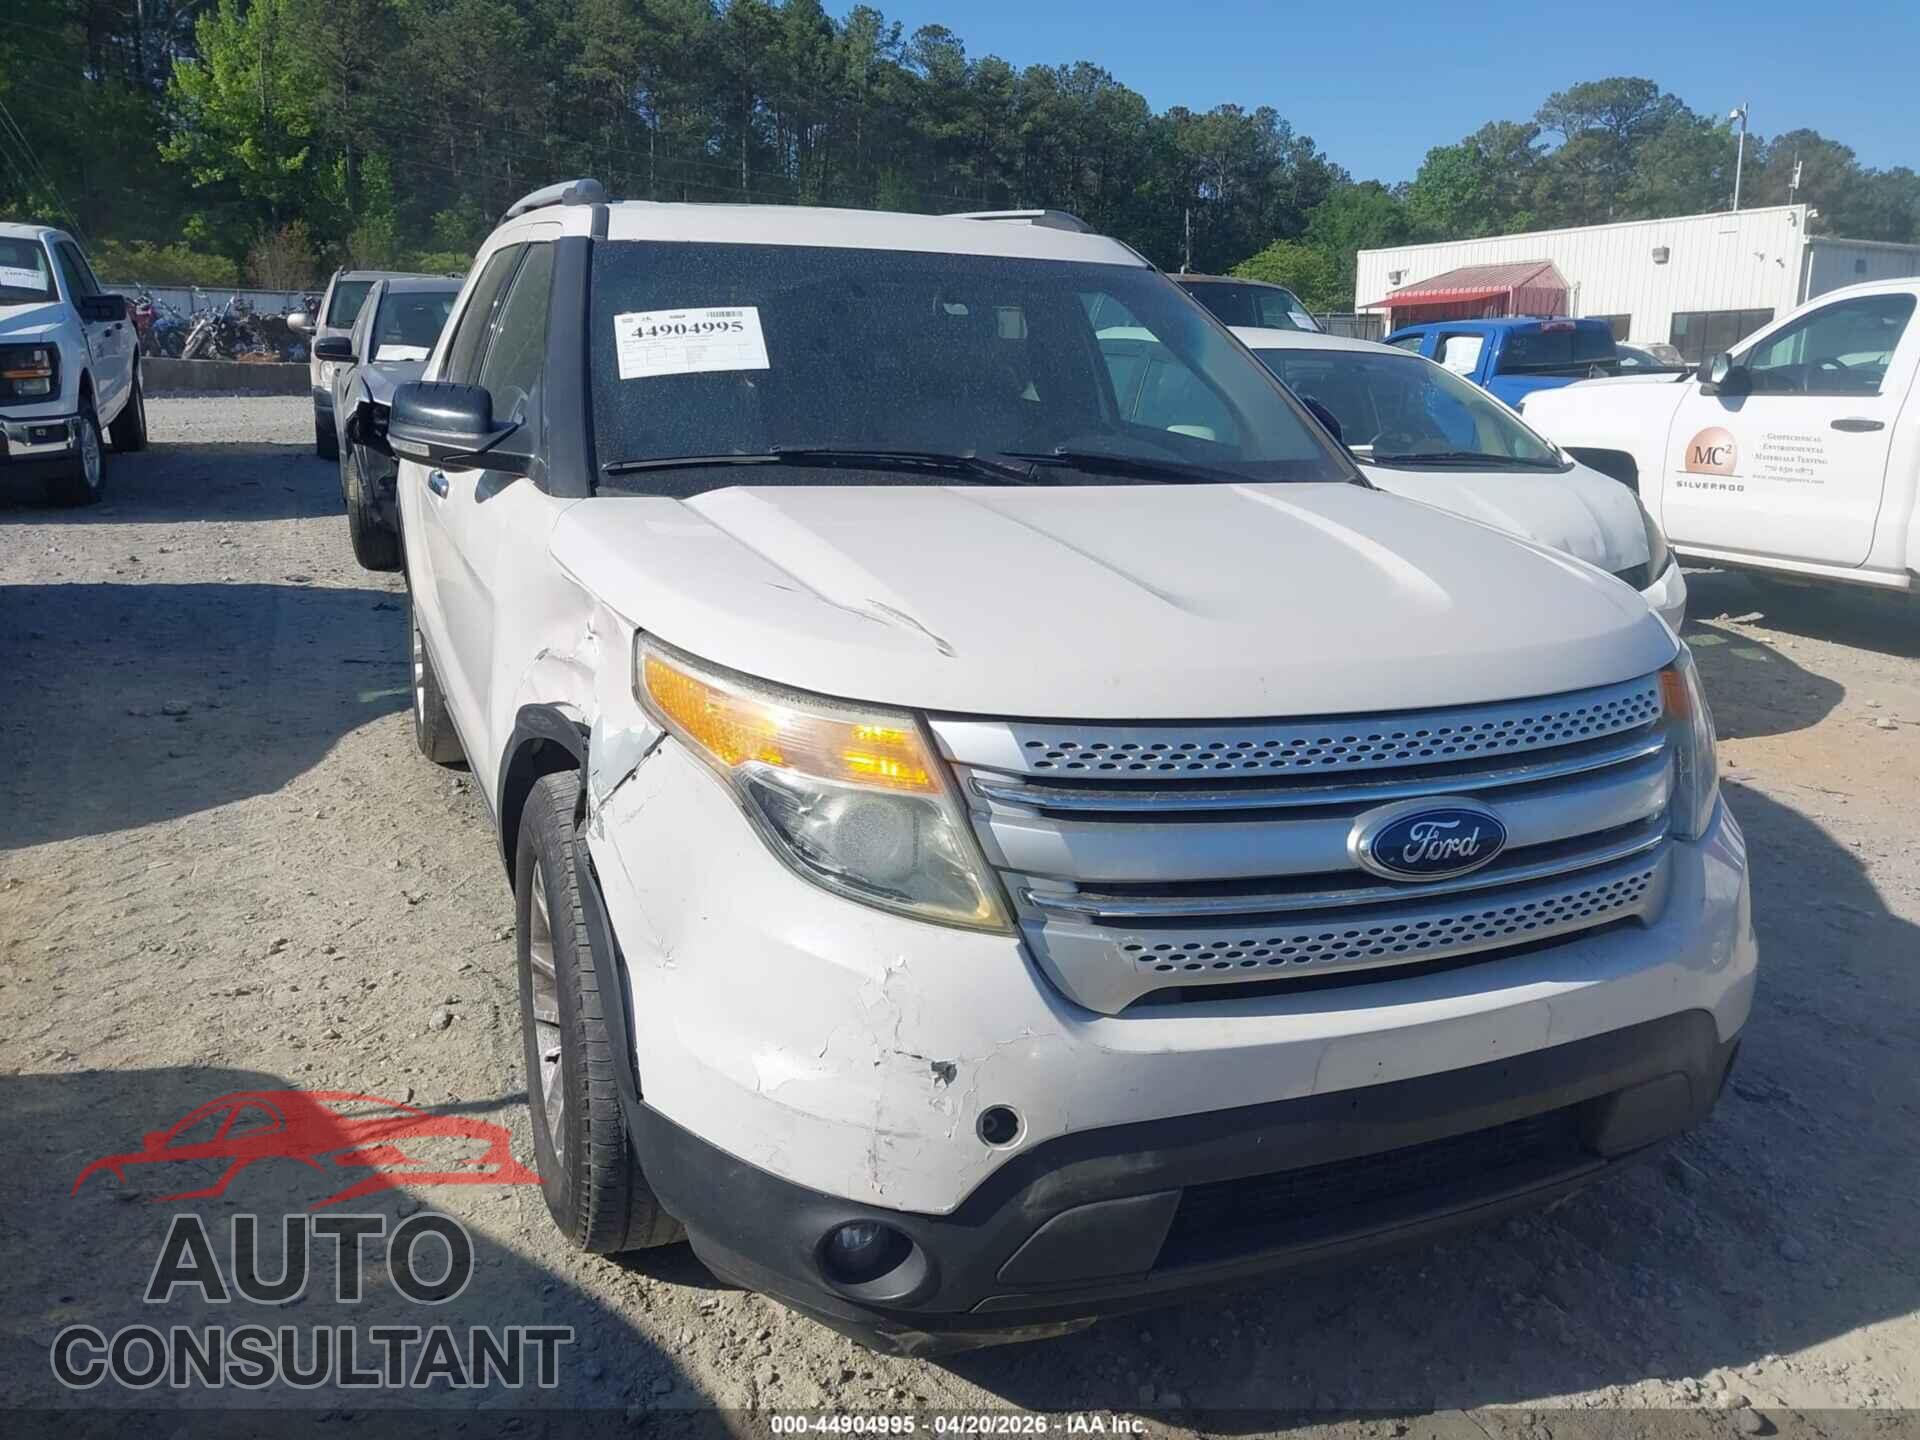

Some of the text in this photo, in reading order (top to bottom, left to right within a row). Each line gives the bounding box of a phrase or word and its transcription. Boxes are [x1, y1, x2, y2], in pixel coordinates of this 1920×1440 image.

[631, 320, 744, 338] 44904995
[1676, 480, 1745, 492] SILVERADO
[1402, 819, 1481, 864] Ford
